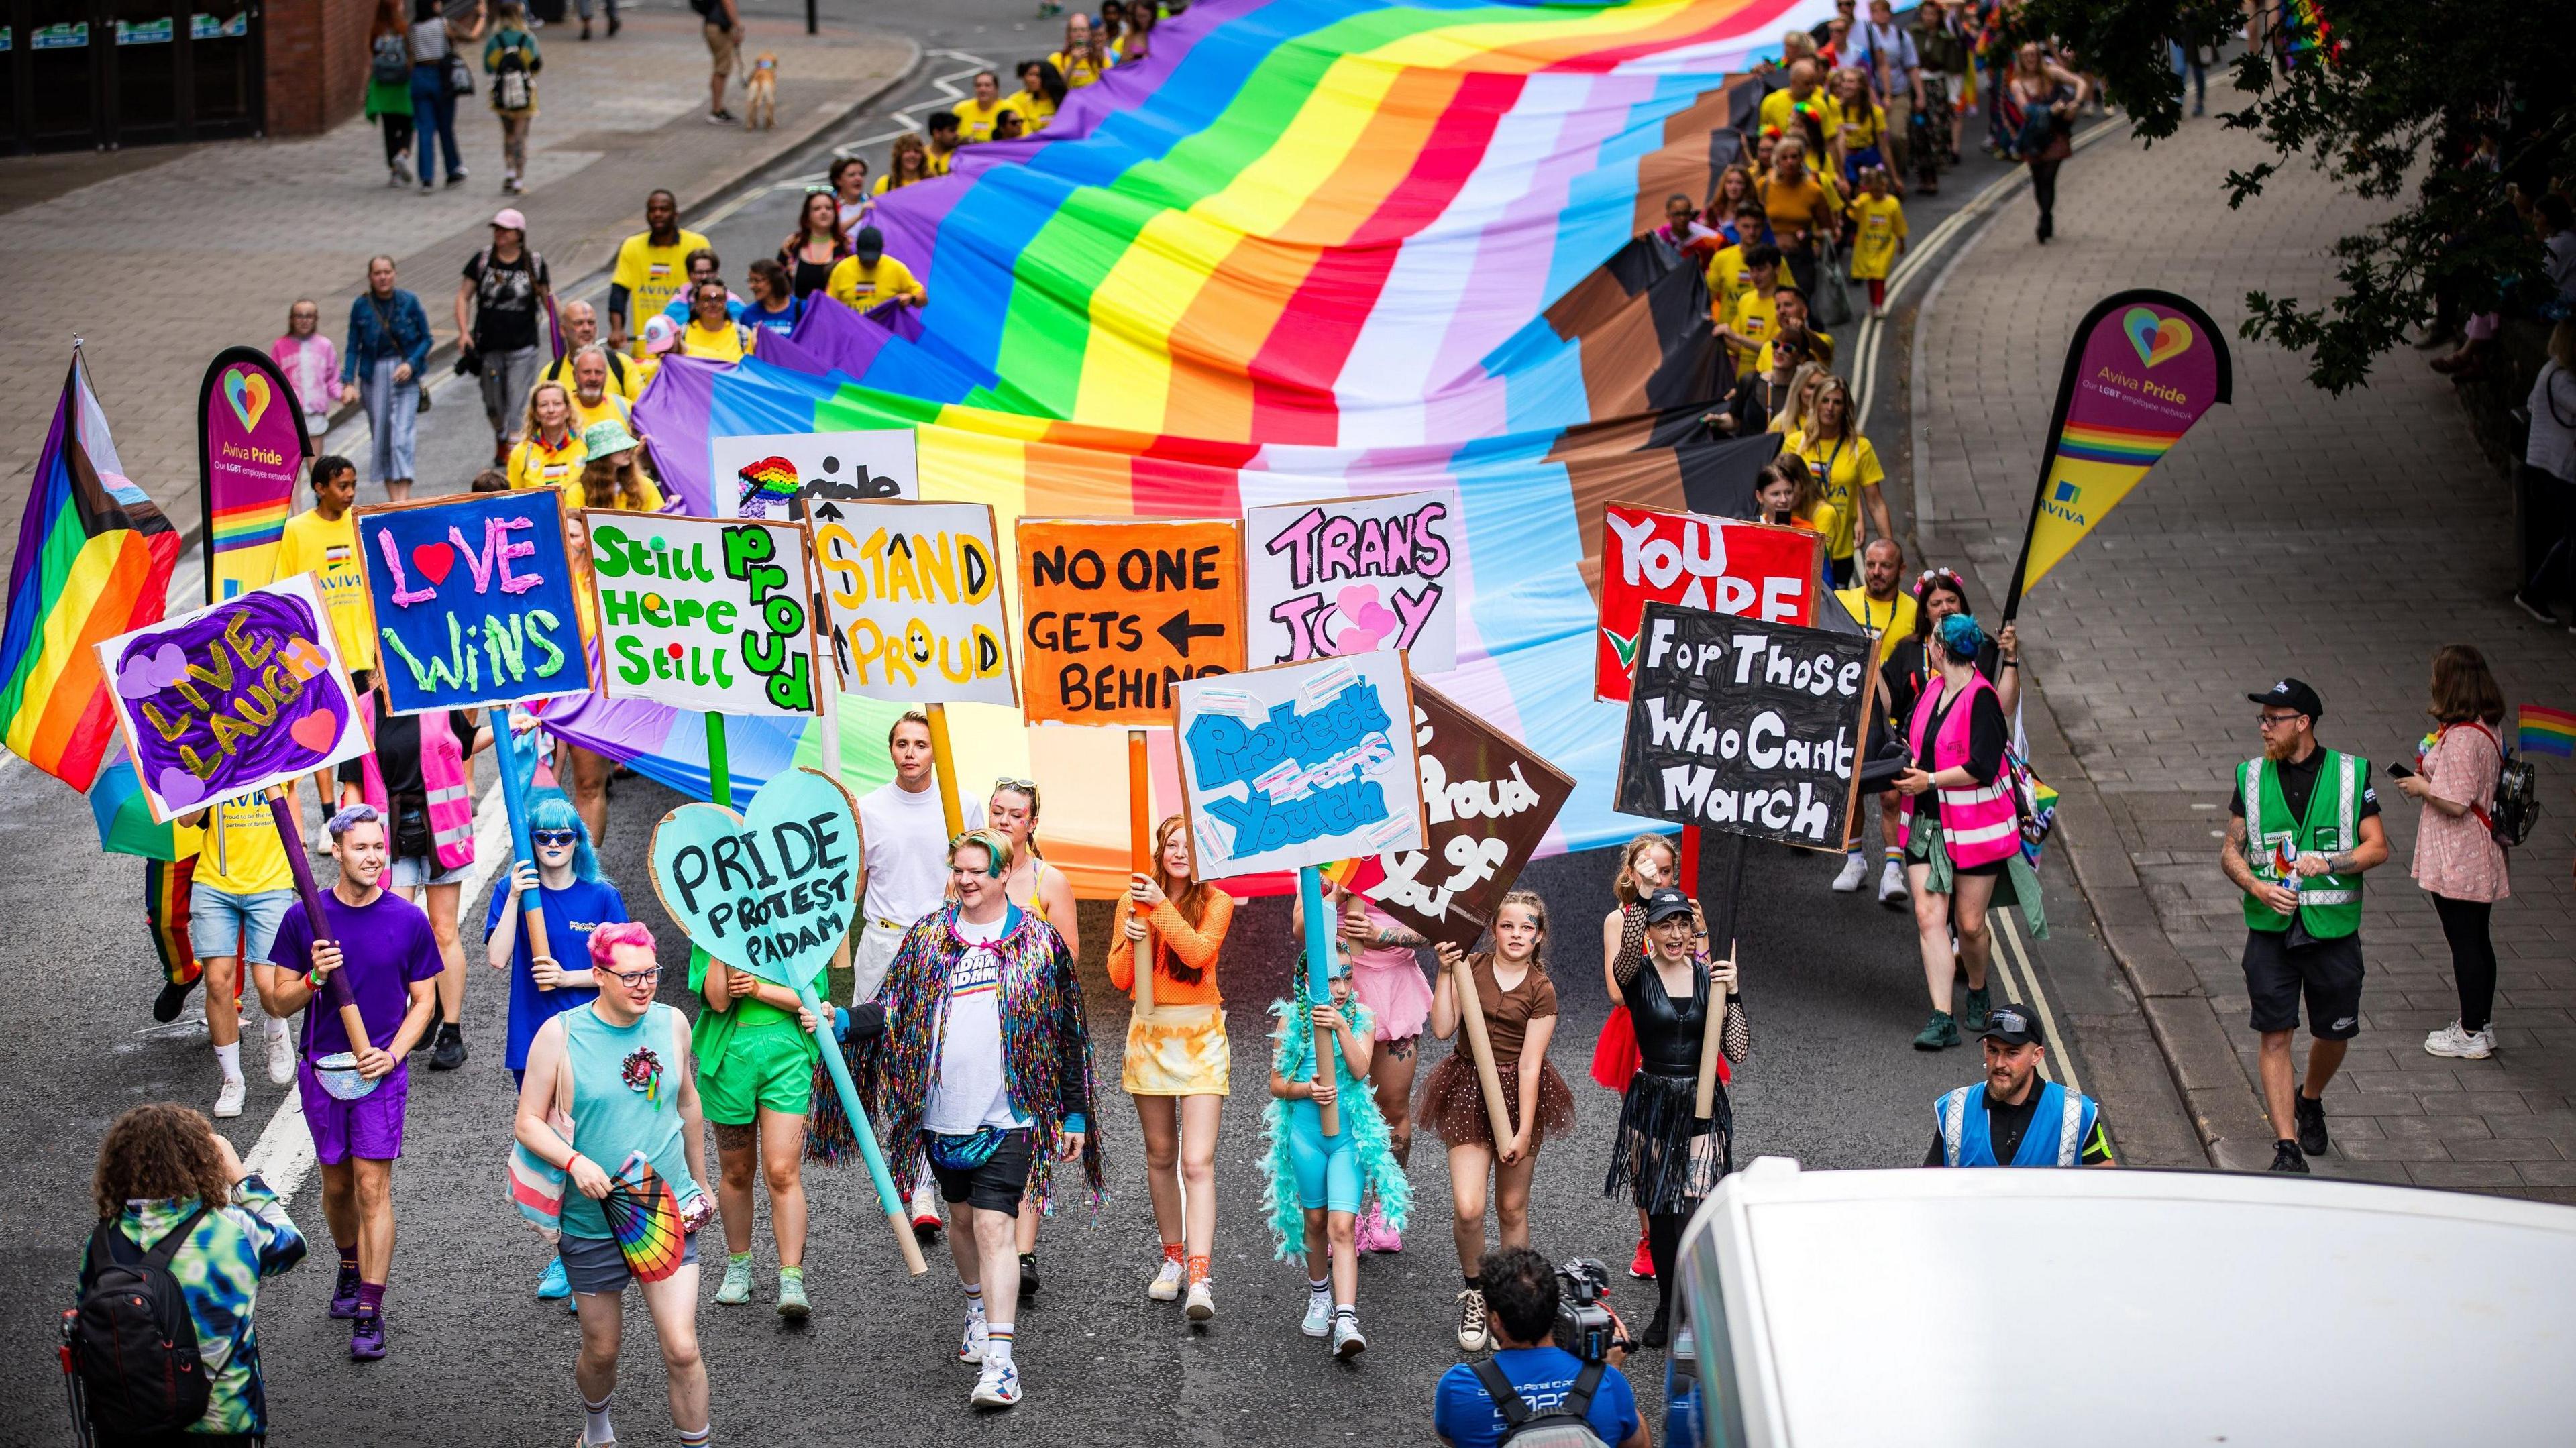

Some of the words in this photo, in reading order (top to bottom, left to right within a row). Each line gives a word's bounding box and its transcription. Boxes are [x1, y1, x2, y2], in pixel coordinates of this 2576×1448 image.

[2082, 379, 2098, 390] Our
[2098, 385, 2121, 399] LGBT
[2121, 394, 2159, 411] employee
[2159, 404, 2192, 420] network
[2098, 366, 2139, 390] Aviva
[2143, 380, 2186, 404] Pride
[214, 461, 226, 470] Our
[227, 463, 241, 473] LGBT
[242, 468, 268, 479] employee
[268, 471, 292, 481] network
[223, 441, 249, 460] Aviva
[252, 447, 282, 466] Pride
[2040, 498, 2084, 526] AVIVA
[591, 525, 715, 583] Still
[816, 523, 996, 610] STAND
[1032, 545, 1106, 591] NO
[1117, 545, 1221, 592] ONE
[1265, 502, 1451, 590] TRANS
[319, 574, 362, 590] AVIVA
[601, 590, 737, 634] Here
[614, 635, 733, 690] Still
[847, 617, 1005, 688] PROUD
[1028, 610, 1143, 654] GETS
[1646, 618, 1722, 676] For
[1732, 634, 1862, 697] Those
[142, 609, 276, 742] LIVE
[179, 631, 327, 781] LAUGH
[1189, 684, 1390, 789] Protect
[1643, 697, 1741, 759] Who
[1747, 710, 1854, 779] Cant
[225, 821, 246, 829] partner
[254, 818, 272, 827] Bristol
[1212, 763, 1387, 855] Youth
[1661, 763, 1829, 840] March
[672, 812, 848, 915] PRIDE
[1362, 850, 1454, 924] You
[708, 869, 849, 938] PROTEST
[745, 910, 845, 966] PADAM
